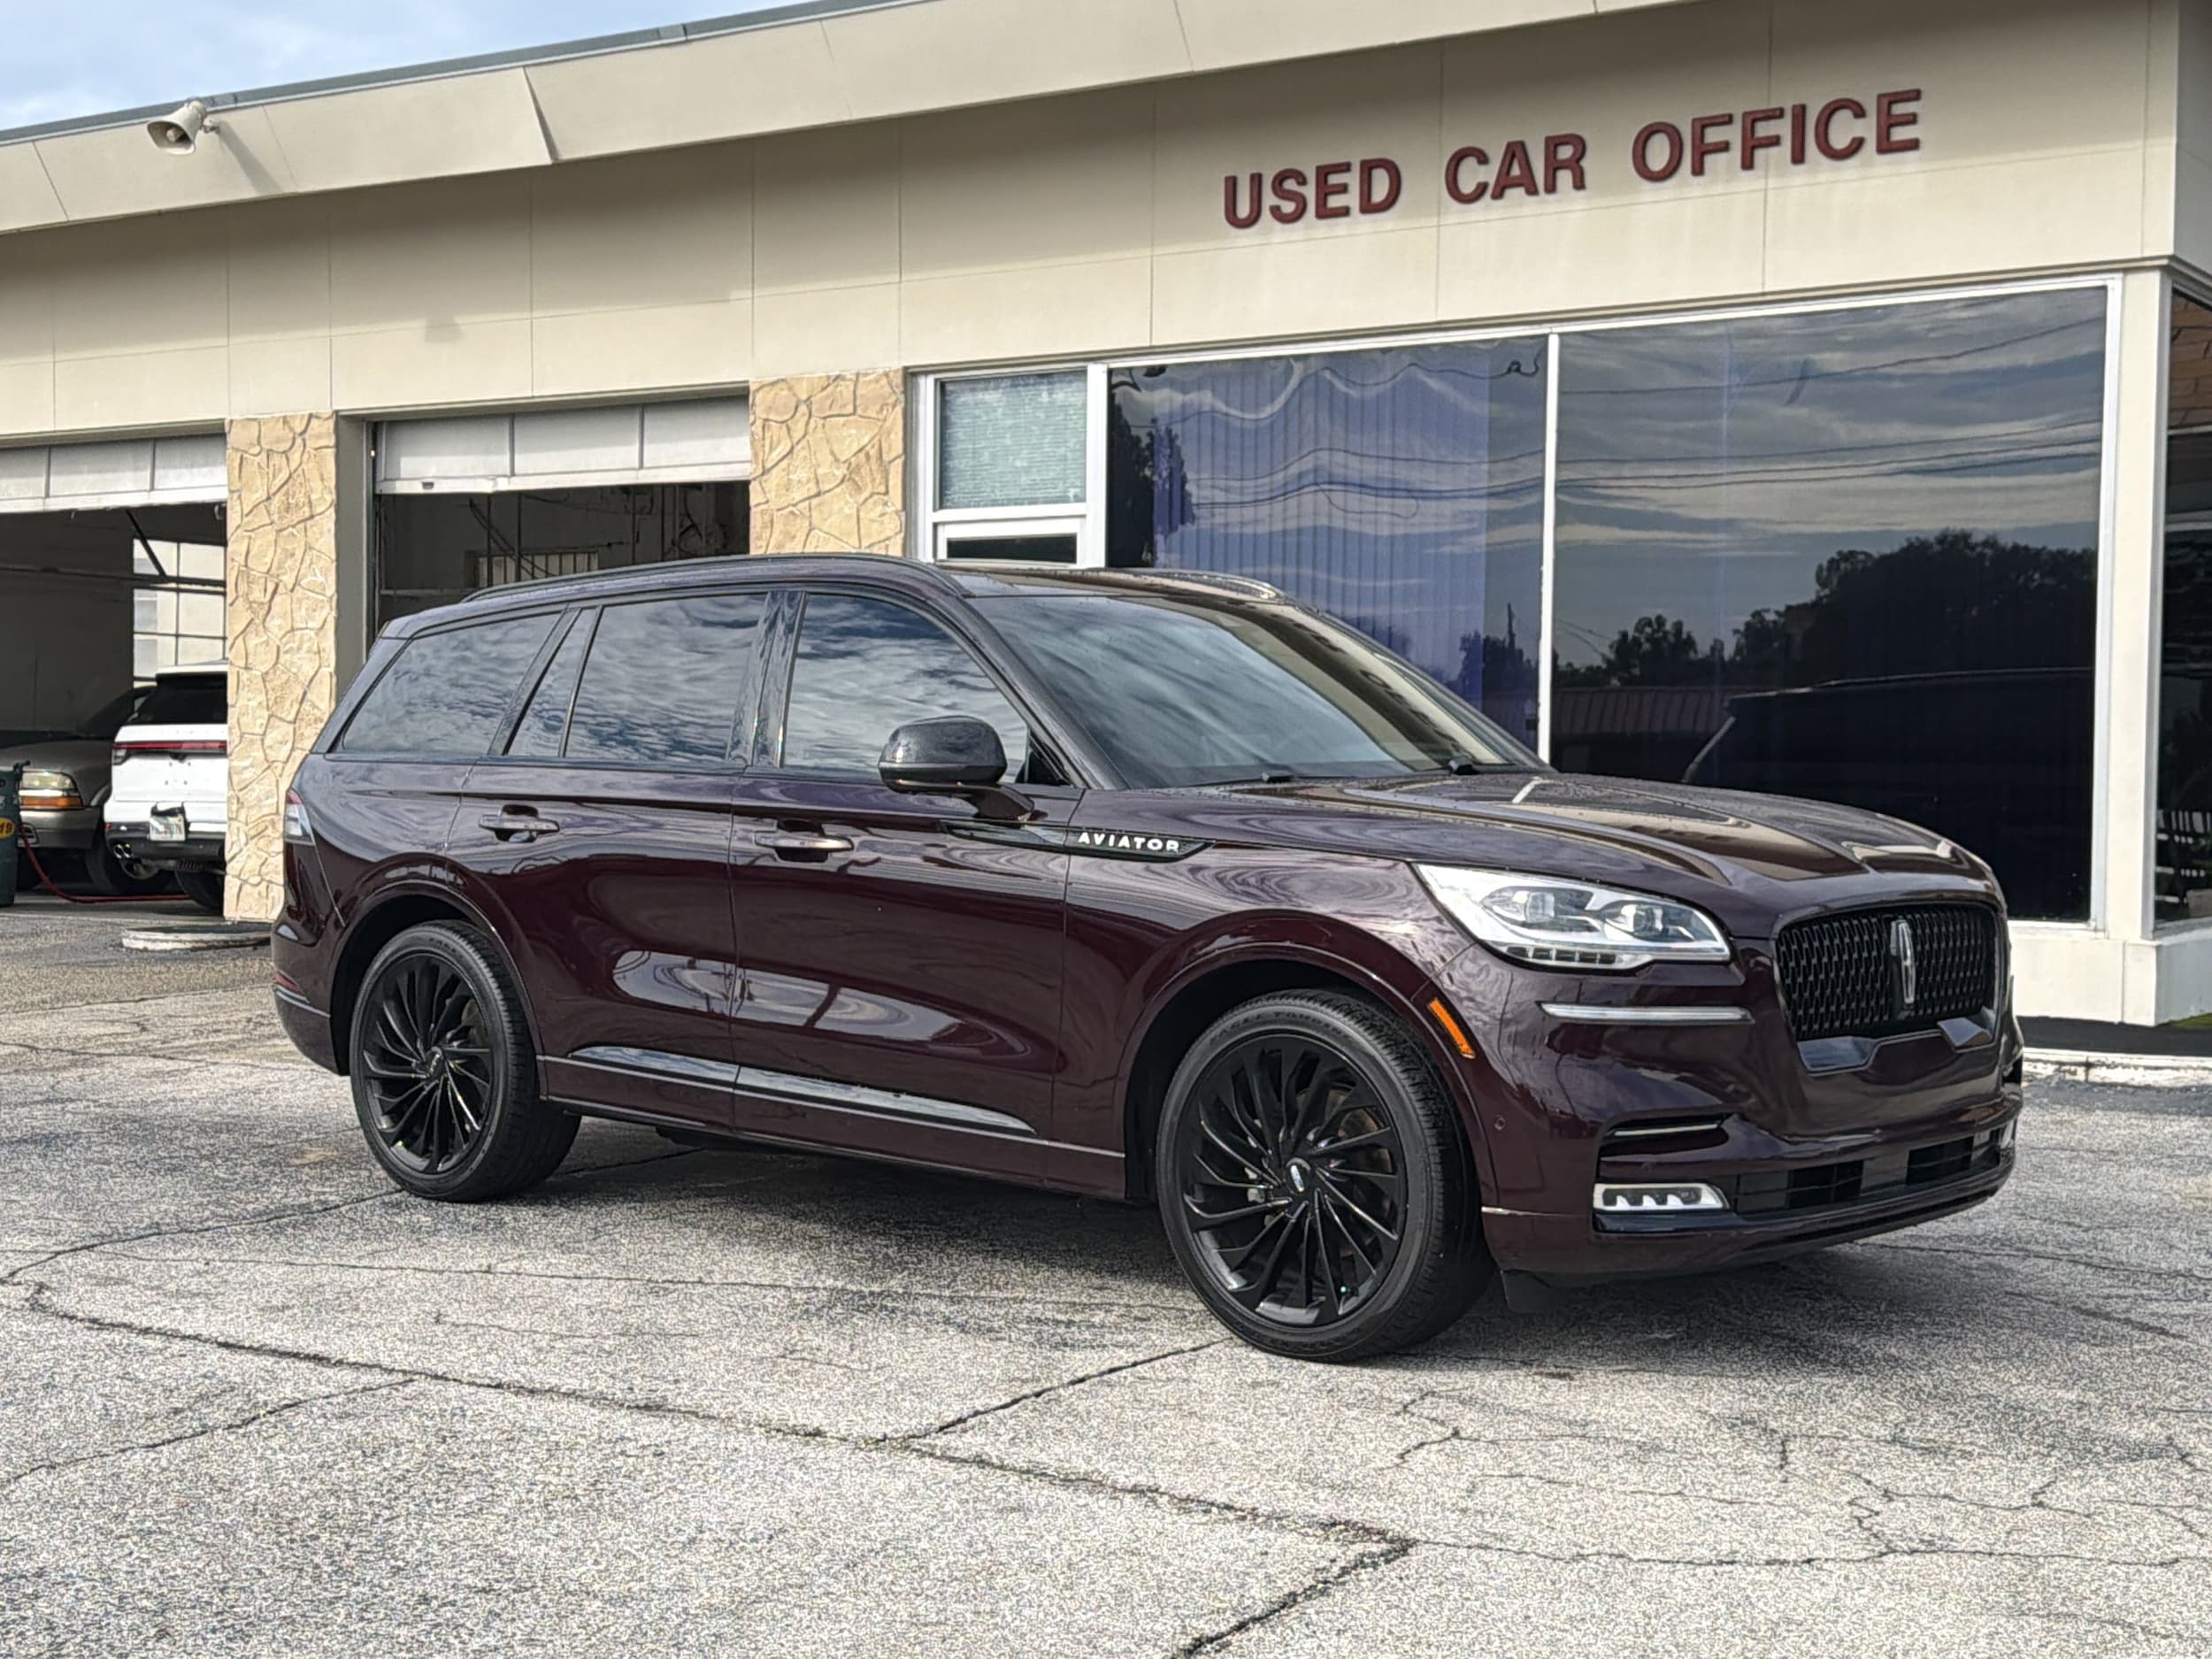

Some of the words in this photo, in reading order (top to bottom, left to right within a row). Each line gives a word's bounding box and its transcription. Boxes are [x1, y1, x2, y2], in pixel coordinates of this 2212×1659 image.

[1223, 157, 1403, 230] USED
[1444, 133, 1587, 205] CAR
[1631, 88, 1923, 184] OFFICE
[1077, 832, 1180, 854] AVIATOR
